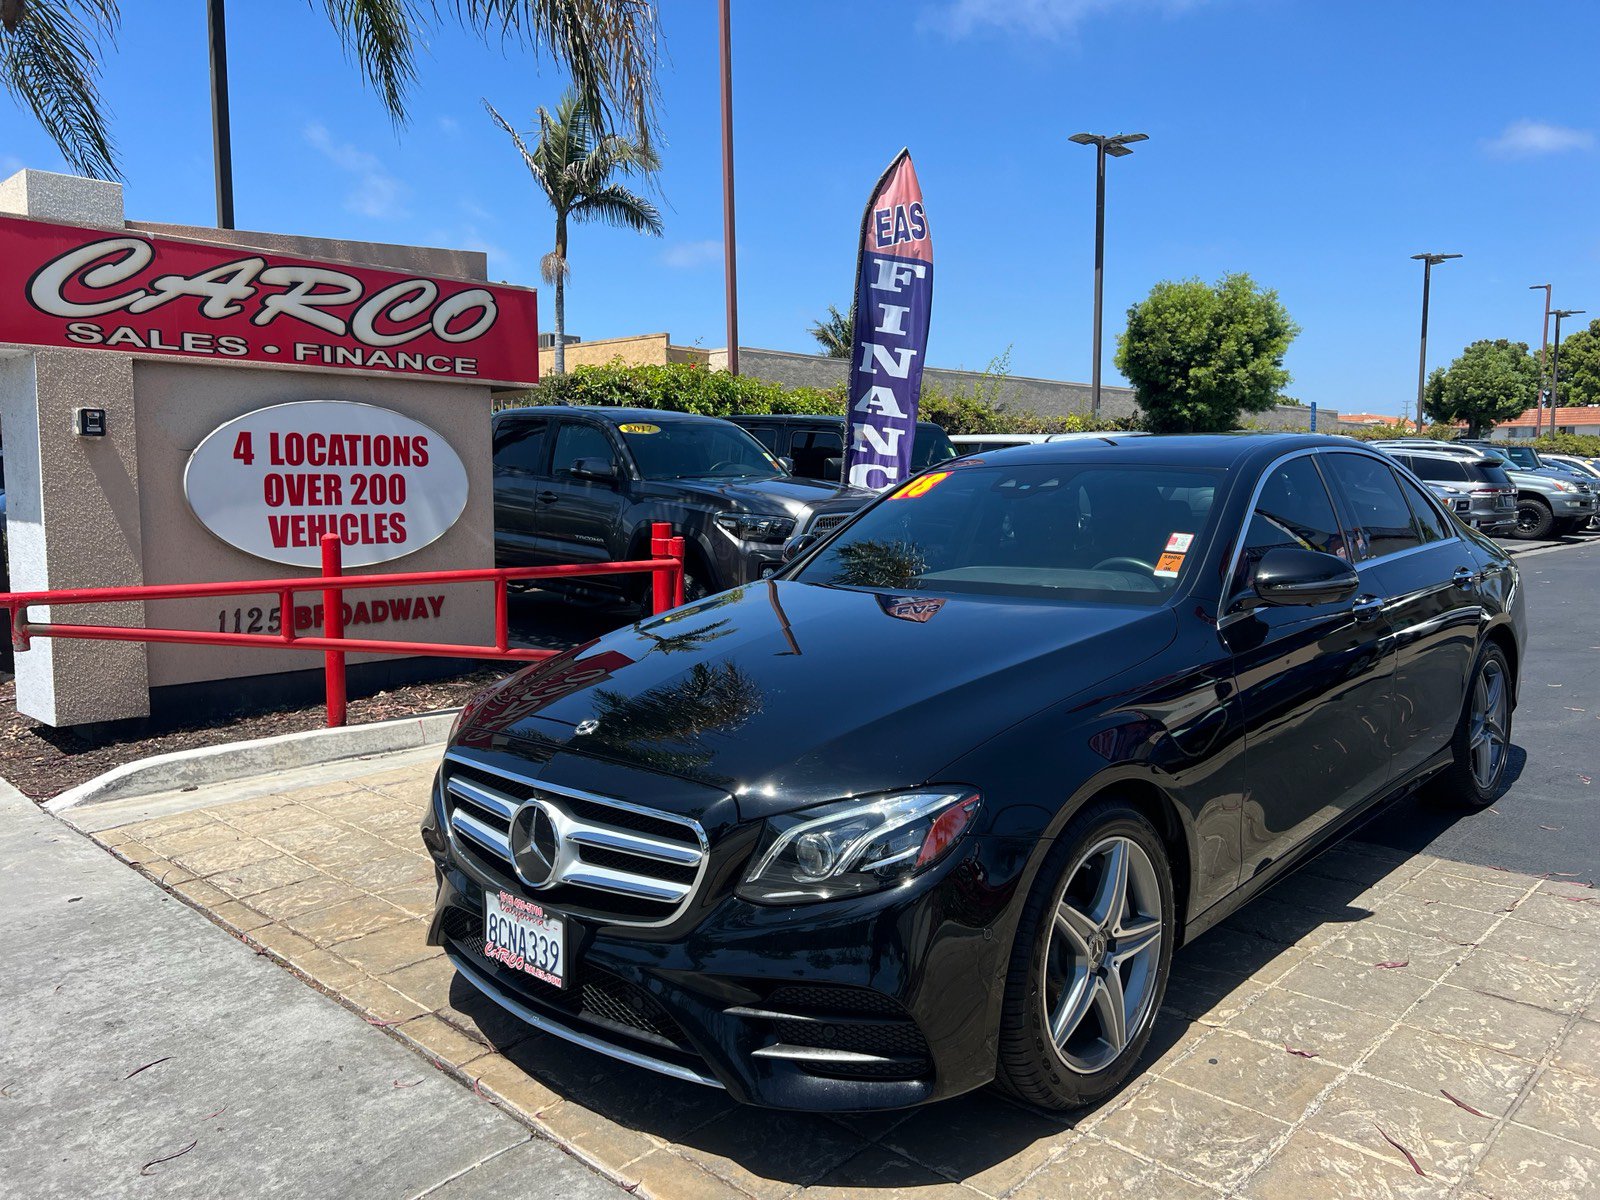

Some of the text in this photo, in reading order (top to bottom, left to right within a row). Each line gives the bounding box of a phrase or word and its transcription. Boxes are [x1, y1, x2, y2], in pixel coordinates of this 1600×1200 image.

[26, 236, 498, 347] CARCO
[66, 321, 479, 376] SALES FINANCE
[627, 424, 652, 433] 2017
[232, 431, 430, 468] 4 LOCATIONS
[263, 472, 407, 507] OVER 200
[890, 472, 948, 500] 18
[267, 512, 408, 549] VEHICLES
[217, 607, 282, 634] 1125
[488, 912, 560, 973] 8CNA339
